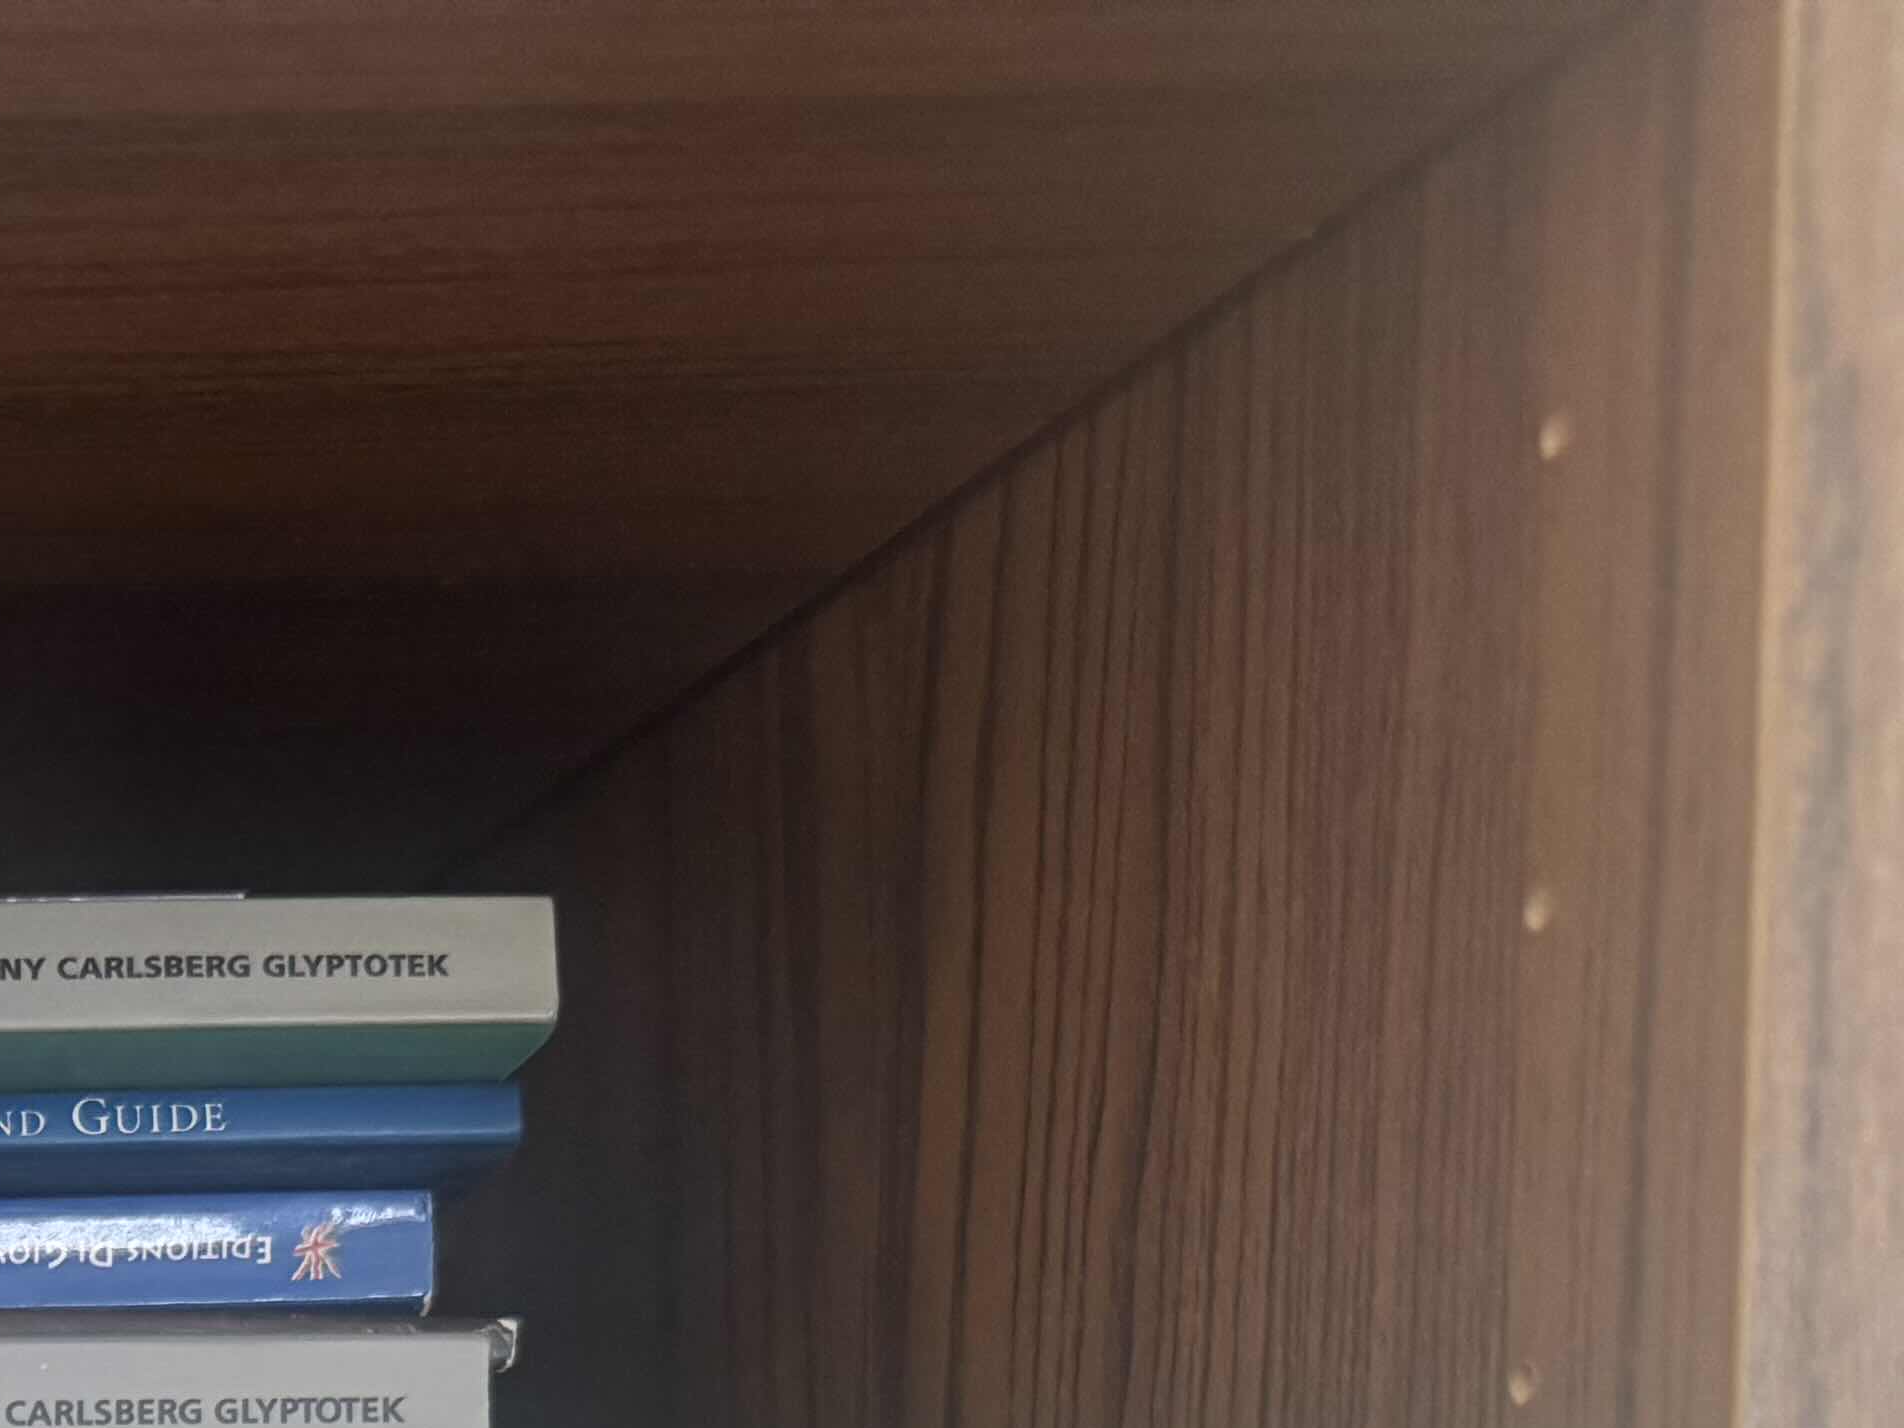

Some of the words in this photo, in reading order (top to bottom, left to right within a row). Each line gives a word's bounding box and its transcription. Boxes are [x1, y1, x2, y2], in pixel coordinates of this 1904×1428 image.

[56, 955, 251, 980] CARLSBERG
[263, 953, 450, 979] GLYPTOTEK
[5, 1399, 202, 1427] CARLSBERG
[215, 1395, 405, 1425] GLYPTOTEK
